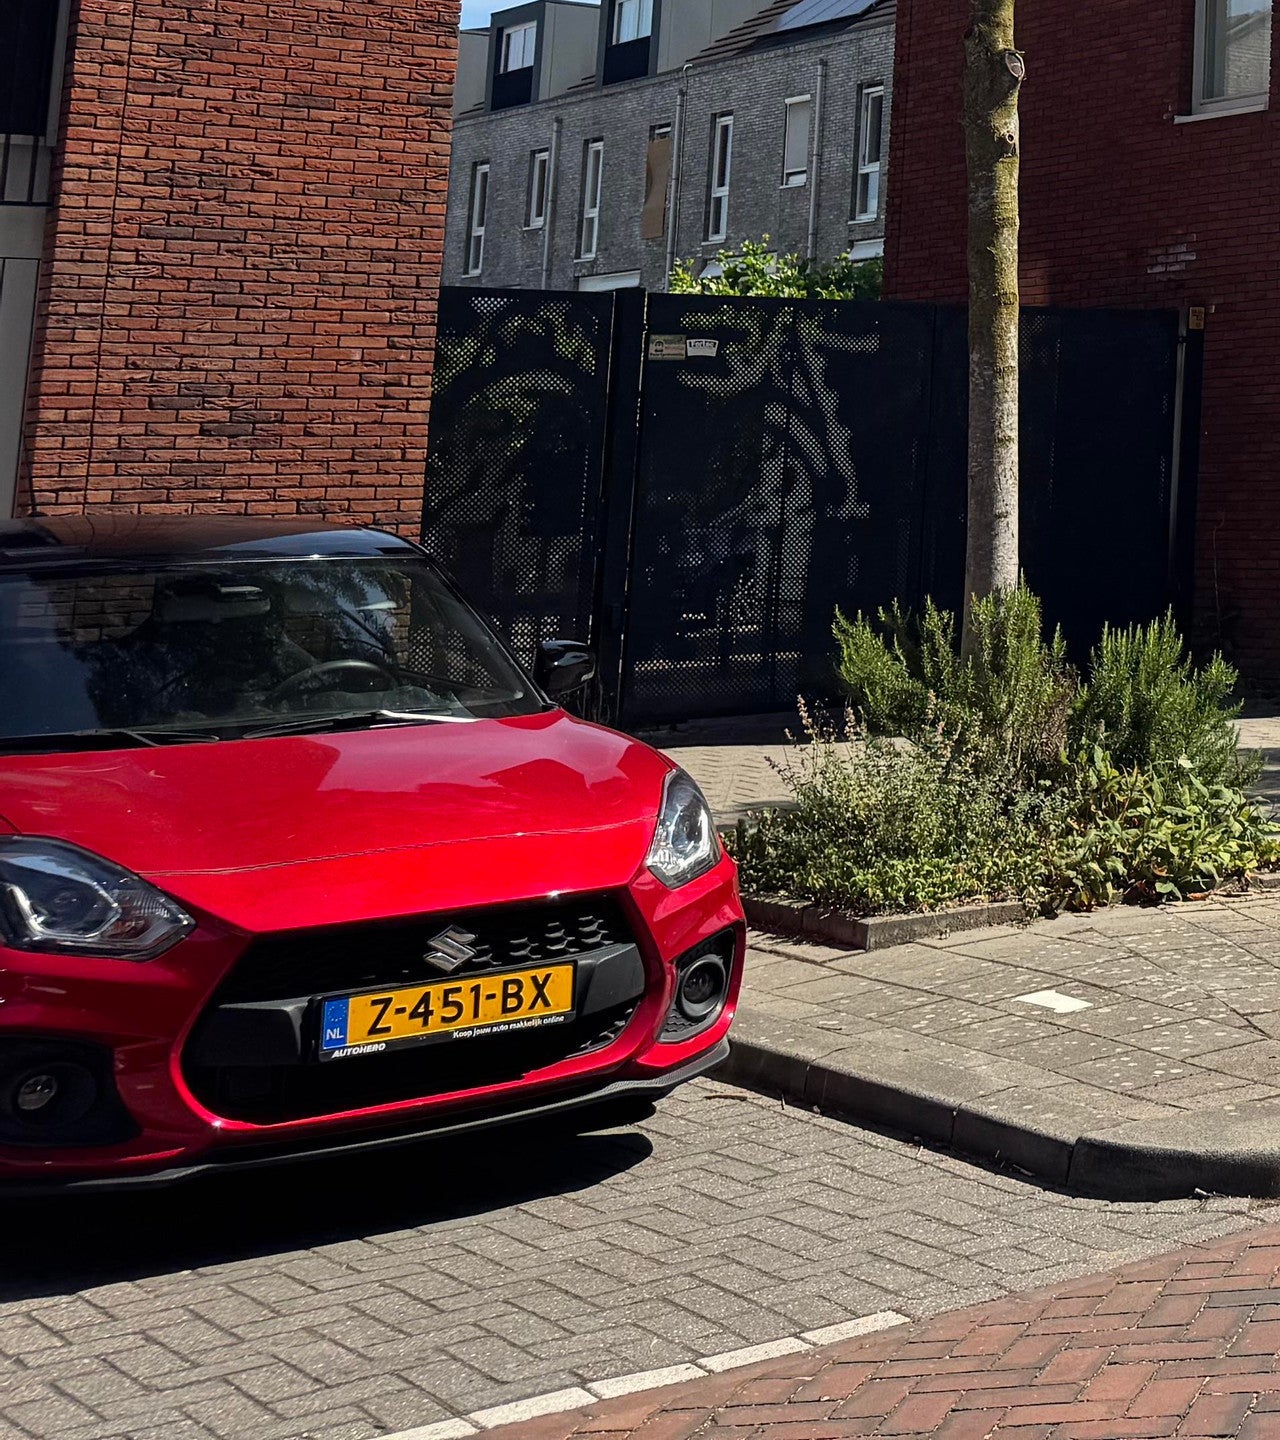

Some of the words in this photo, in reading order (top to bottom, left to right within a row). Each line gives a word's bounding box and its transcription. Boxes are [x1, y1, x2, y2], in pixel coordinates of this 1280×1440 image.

[326, 1027, 345, 1040] NL
[367, 972, 553, 1037] Z-451-BX
[453, 1030, 473, 1039] Koop
[473, 1027, 492, 1037] jouw
[492, 1024, 509, 1032] auto
[509, 1016, 543, 1030] makkelijk
[543, 1015, 565, 1024] online
[331, 1042, 387, 1059] AUTOHERO
